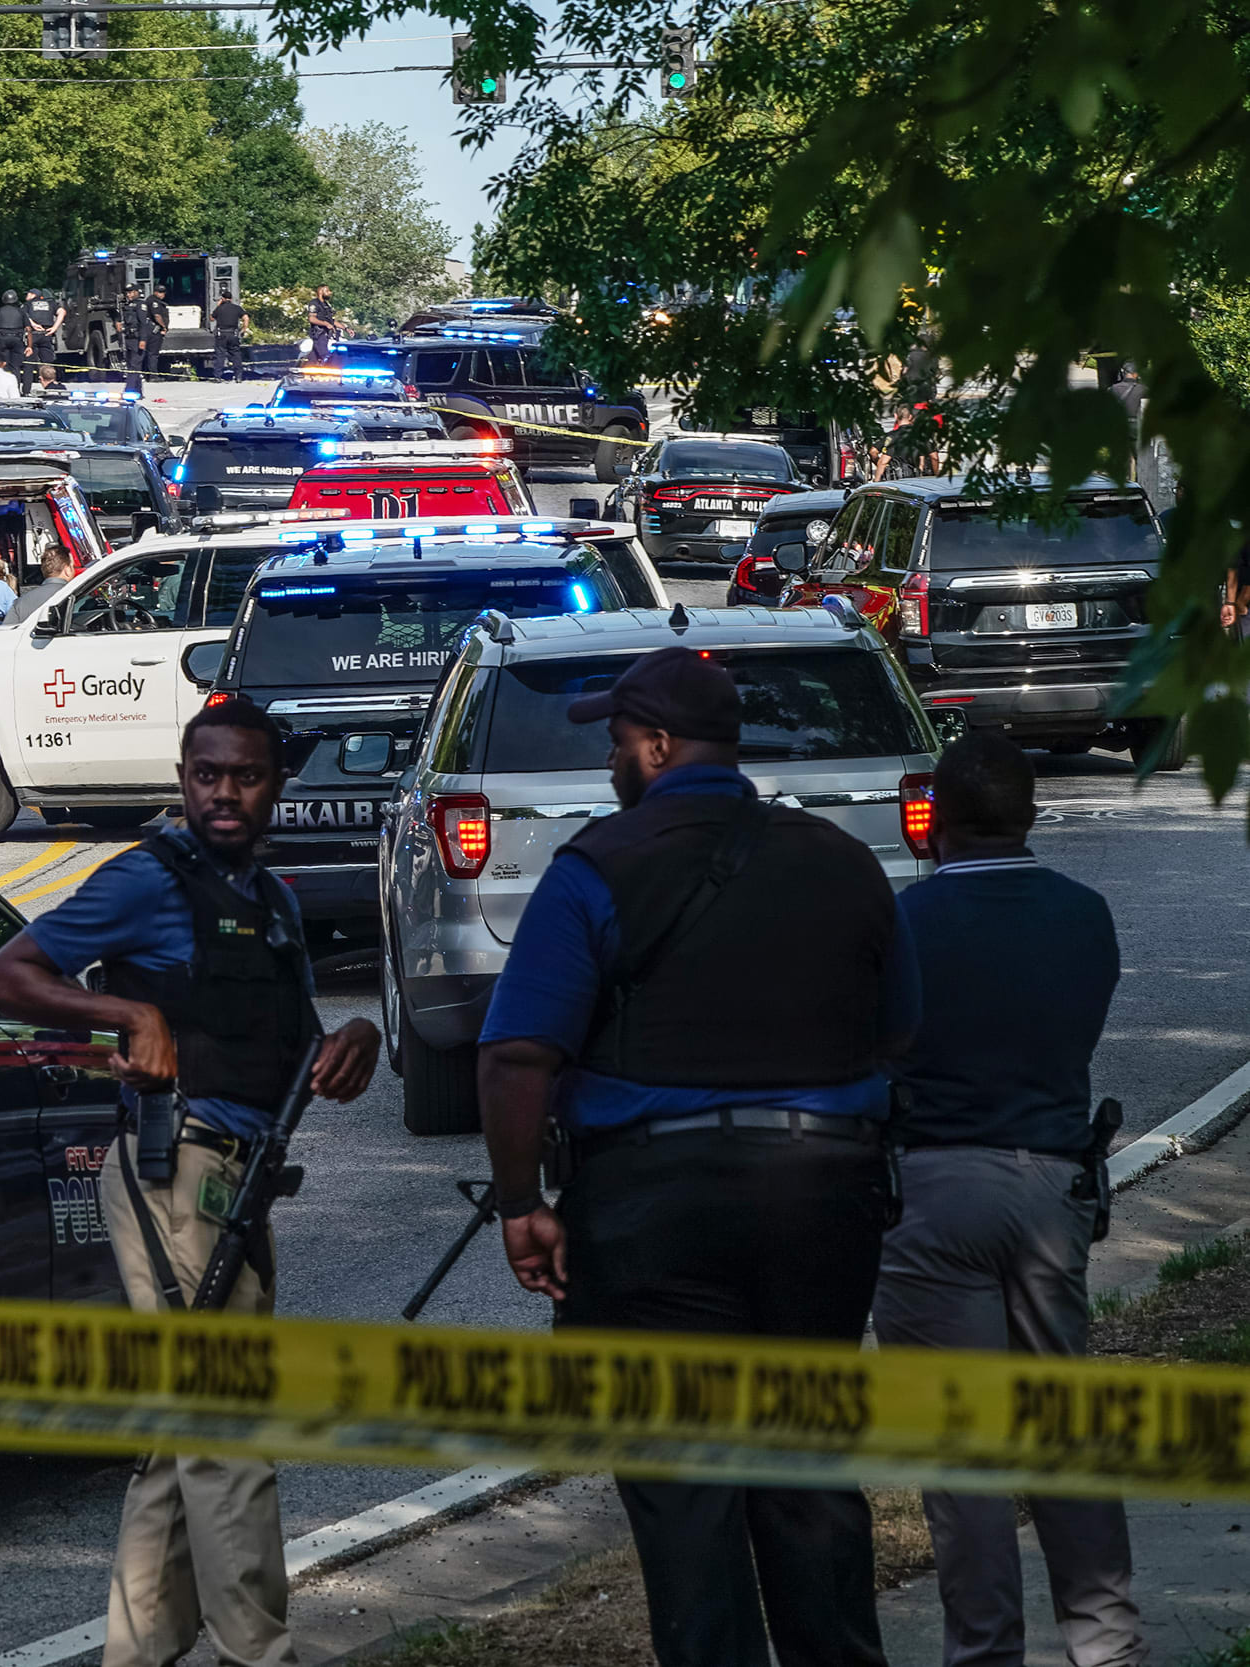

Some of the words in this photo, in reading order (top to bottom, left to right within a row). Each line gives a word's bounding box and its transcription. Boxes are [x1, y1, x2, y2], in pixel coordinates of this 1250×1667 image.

[505, 403, 581, 424] POLICE
[225, 466, 241, 475] WE
[242, 465, 260, 474] ARE
[261, 466, 292, 475] HIRING
[693, 498, 733, 510] ATLANTA
[332, 655, 362, 672] WE
[365, 652, 404, 669] ARE
[408, 650, 451, 667] HIRI
[81, 671, 146, 702] Grady
[45, 715, 87, 725] Emergency
[88, 713, 118, 723] Medical
[120, 712, 147, 722] Service
[25, 732, 73, 748] 11361
[53, 1322, 90, 1390] DO
[102, 1325, 161, 1392] NOT
[172, 1329, 279, 1401] CROSS
[396, 1340, 513, 1414] POLICE
[522, 1346, 599, 1421] LINE
[609, 1350, 655, 1424] DO
[668, 1355, 740, 1426] NOT
[750, 1359, 873, 1437] CROSS
[1009, 1373, 1144, 1450] POLICE
[1157, 1384, 1245, 1457] LINE
